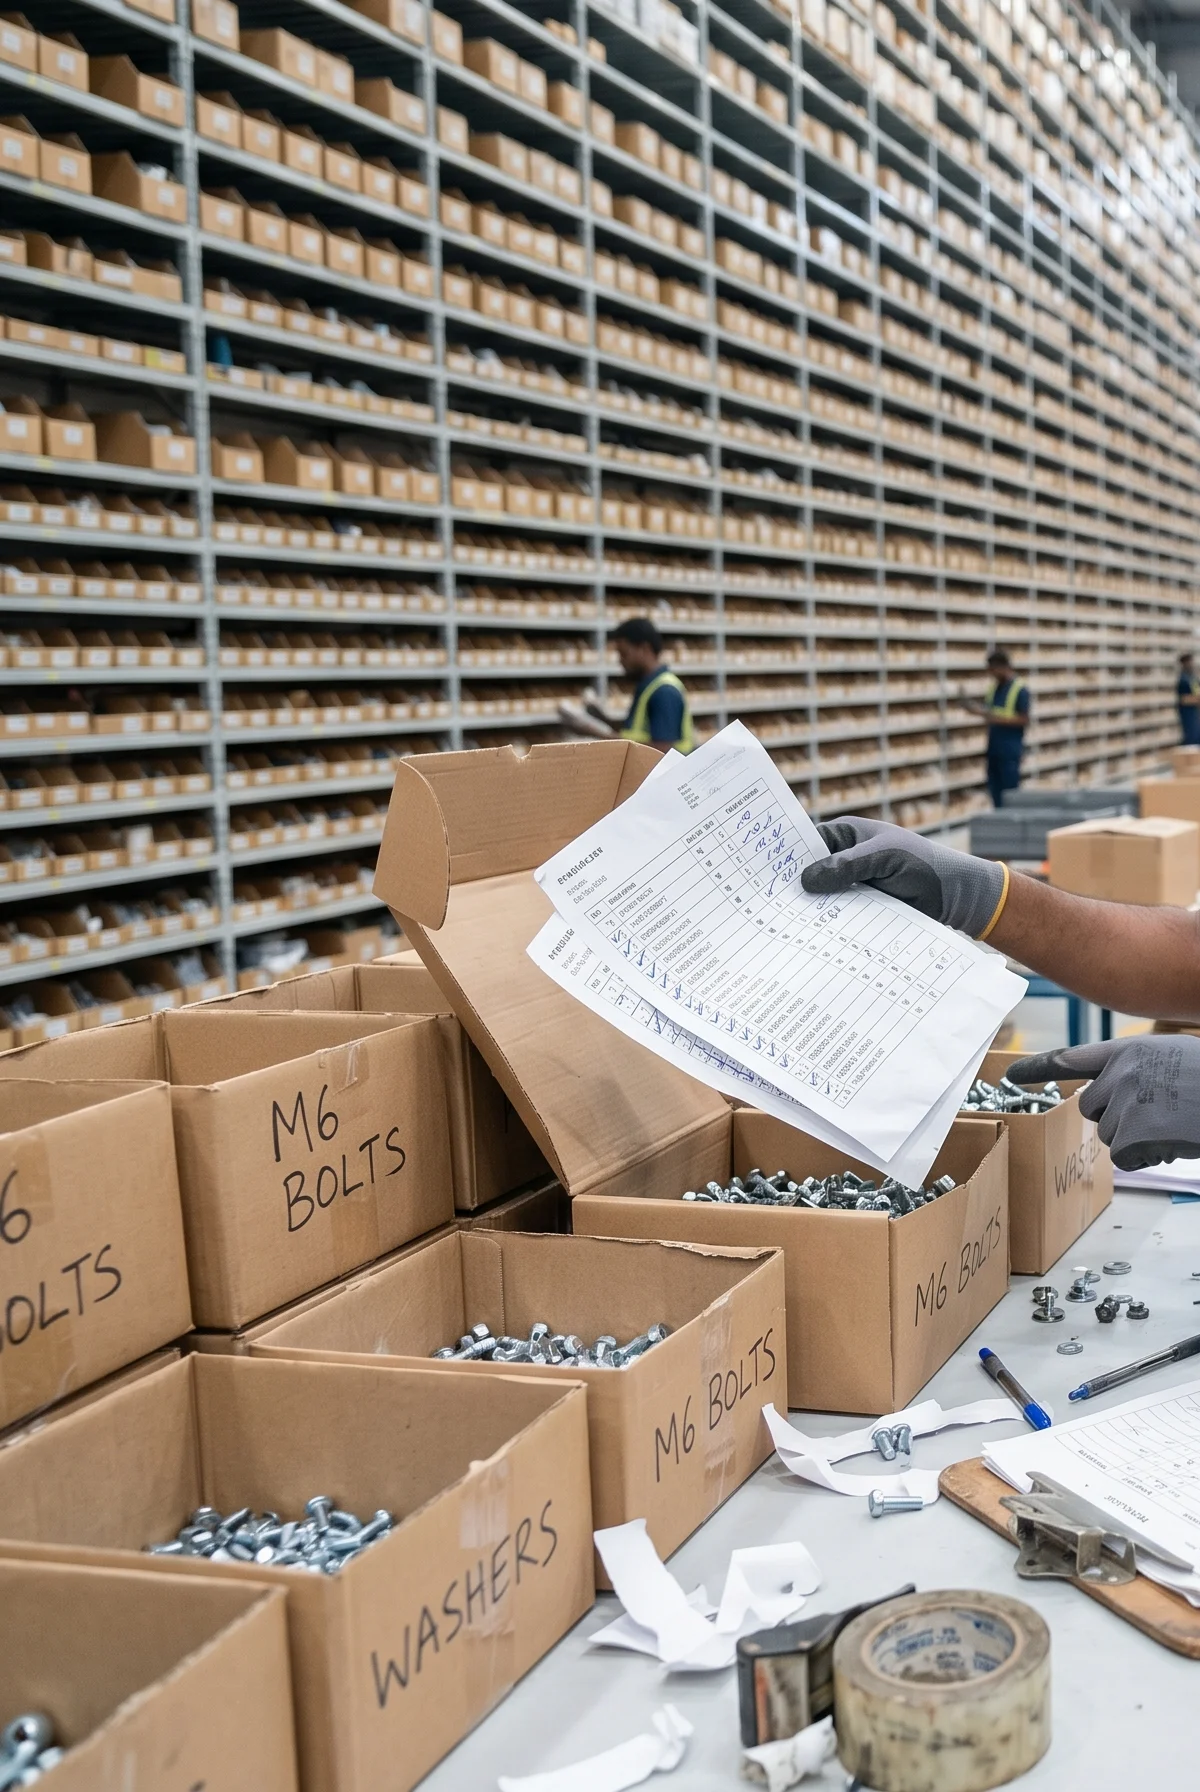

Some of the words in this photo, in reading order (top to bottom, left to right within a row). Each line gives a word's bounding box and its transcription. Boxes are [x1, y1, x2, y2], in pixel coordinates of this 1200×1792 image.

[272, 1083, 339, 1163] M6
[283, 1126, 406, 1233] BOLTS
[0, 1243, 122, 1352] OLTS
[914, 1261, 948, 1327] M6
[957, 1205, 1001, 1294] BOLTS
[655, 1394, 695, 1483] M6
[708, 1327, 776, 1431] BOLTS
[370, 1499, 558, 1709] WASHERS
